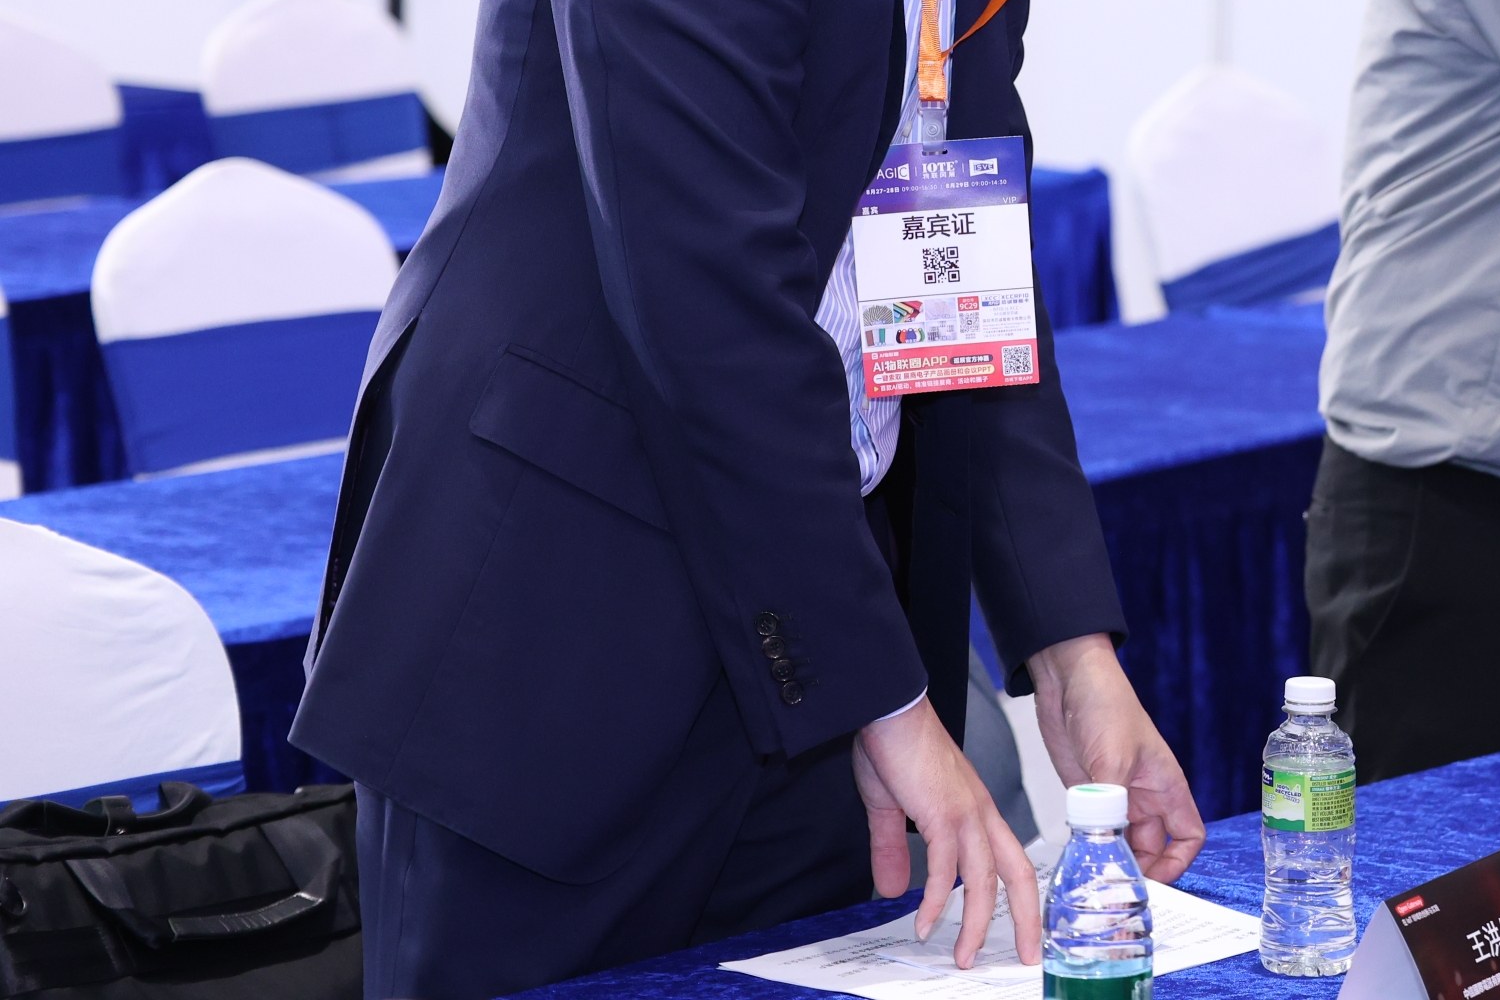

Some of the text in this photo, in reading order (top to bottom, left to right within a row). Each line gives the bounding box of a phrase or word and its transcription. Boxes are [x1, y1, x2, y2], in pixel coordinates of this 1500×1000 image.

[877, 163, 910, 180] AGIC
[922, 161, 955, 173] IOTE
[902, 212, 976, 240] 嘉宾证
[959, 302, 978, 310] 9C29
[873, 356, 948, 372] AI物联圈APP
